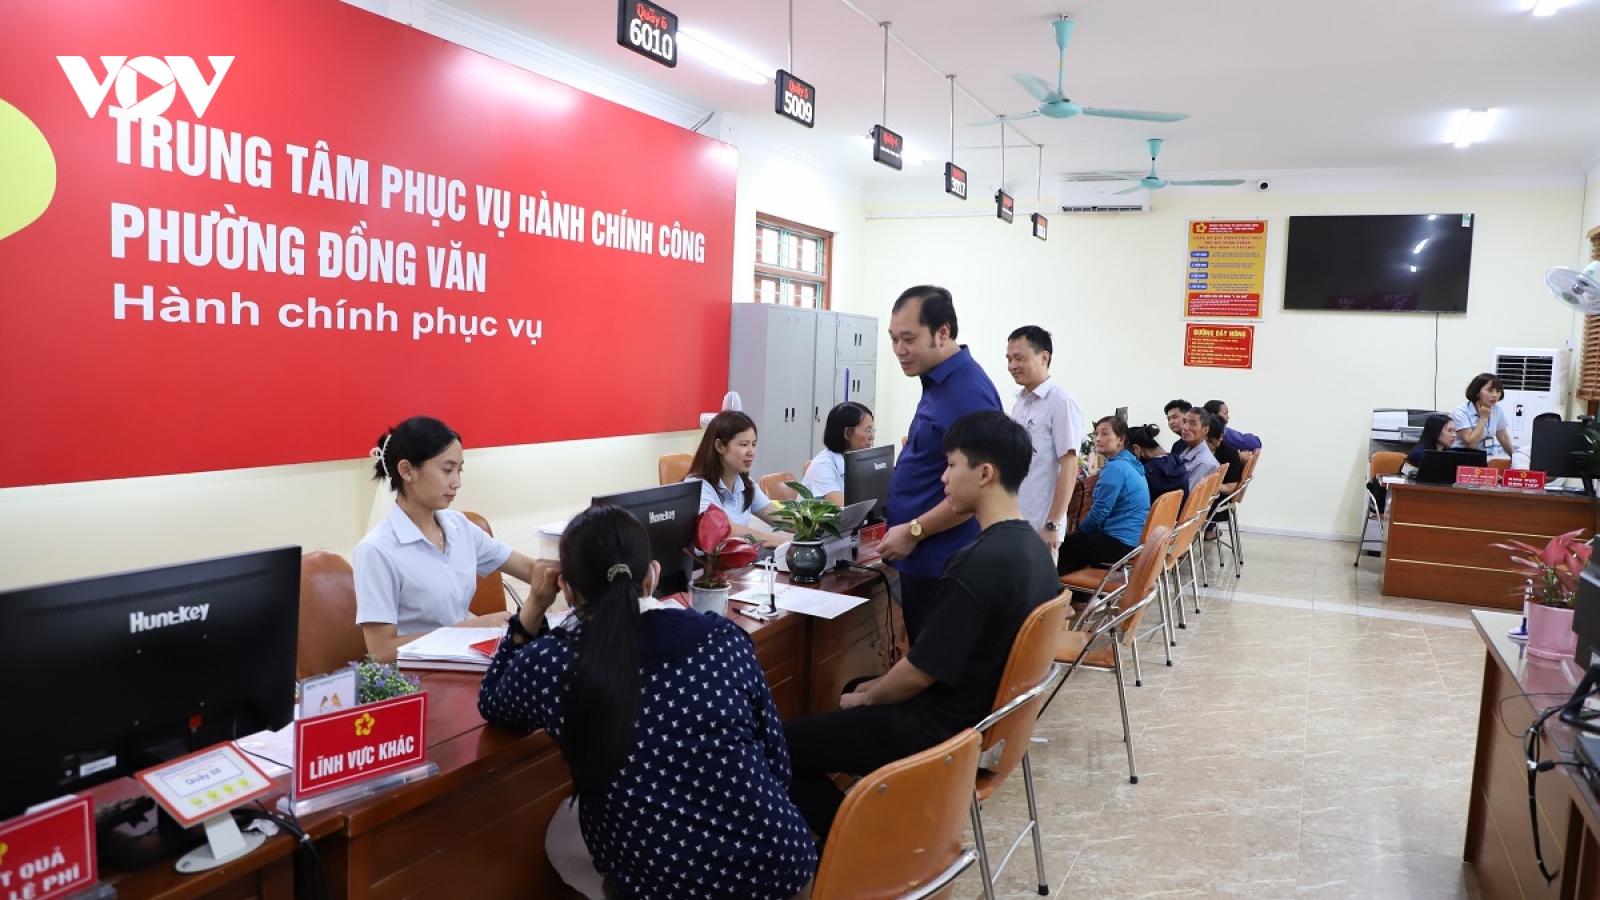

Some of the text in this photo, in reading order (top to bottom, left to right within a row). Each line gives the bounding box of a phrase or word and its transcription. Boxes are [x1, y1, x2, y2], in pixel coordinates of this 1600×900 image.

[636, 3, 668, 30] Quầy 6
[630, 18, 673, 61] 6010
[783, 90, 813, 124] 5009
[108, 104, 706, 264] TRUNG TÂM PHỤC VỤ HÀNH CHÍNH CÔNG
[111, 202, 487, 293] PHƯỜNG ĐỒNG VĂN
[113, 282, 543, 345] Hành chính phục vụ
[309, 735, 415, 780] LĨNH VỰC KHÁC
[19, 846, 66, 880] QUẢ
[43, 862, 80, 892] PHÍ
